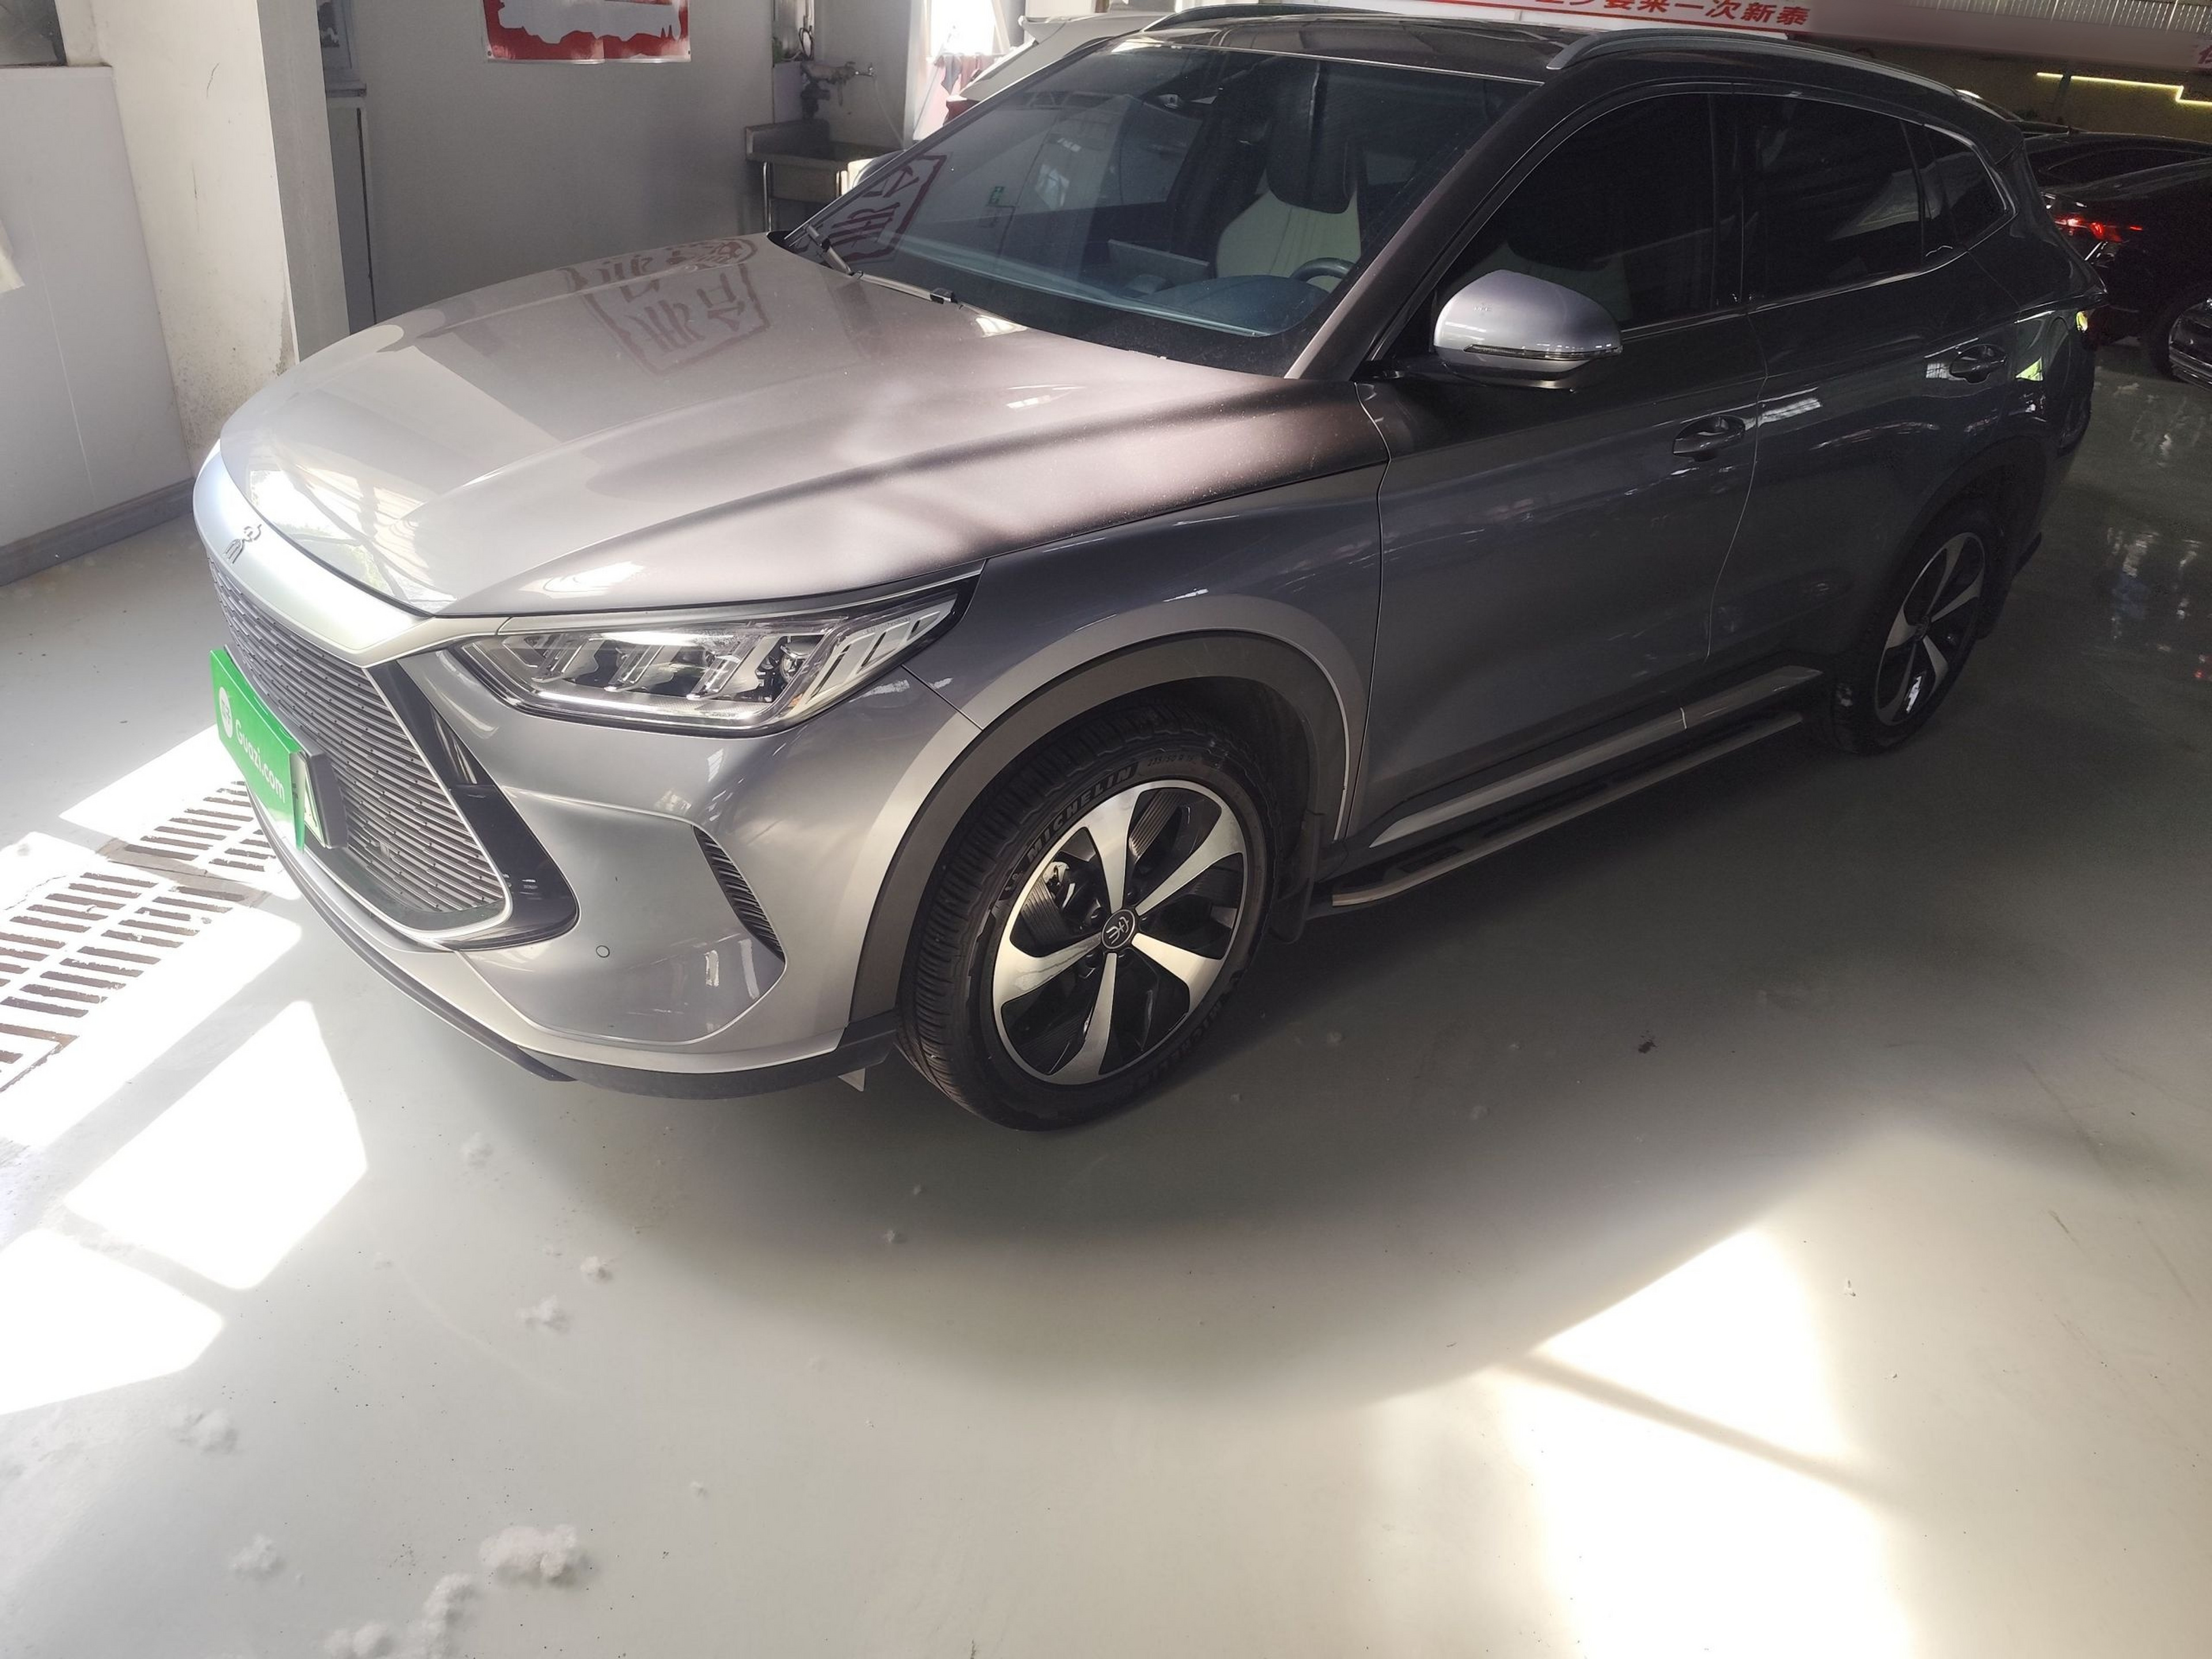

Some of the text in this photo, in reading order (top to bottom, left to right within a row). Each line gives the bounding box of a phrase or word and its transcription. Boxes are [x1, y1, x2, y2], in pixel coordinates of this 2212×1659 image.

[1535, 0, 1810, 25] 来一次新泰
[236, 719, 285, 804] Guazi.com
[1027, 767, 1132, 863] MICHELIN
